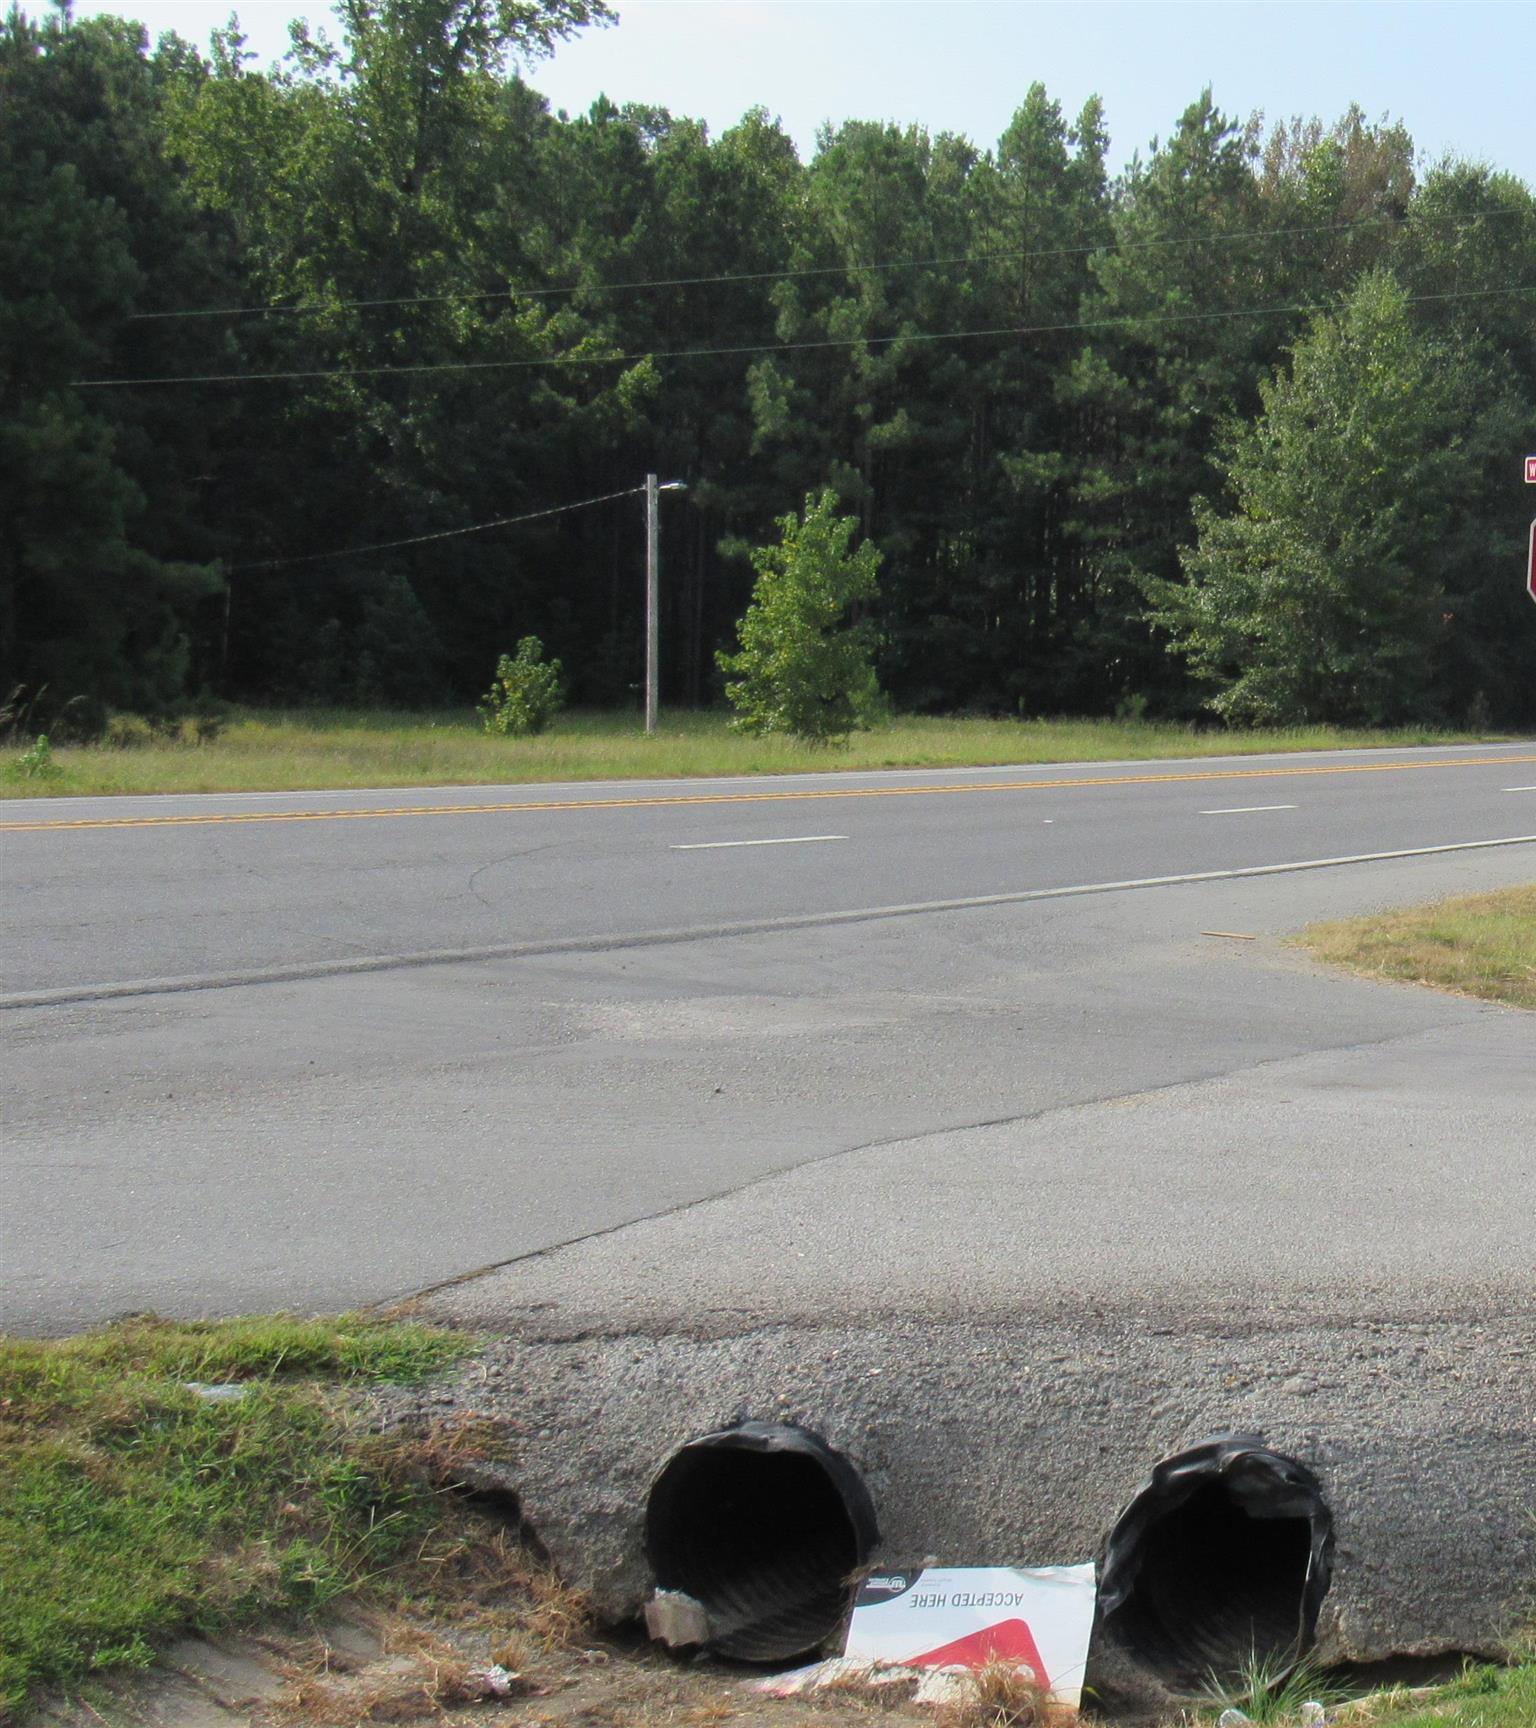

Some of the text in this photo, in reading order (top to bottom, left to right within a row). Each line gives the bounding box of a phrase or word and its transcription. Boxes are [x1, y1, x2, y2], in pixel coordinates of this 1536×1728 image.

[1529, 463, 1536, 477] W
[910, 1592, 1024, 1608] ACCEPTED HERE
